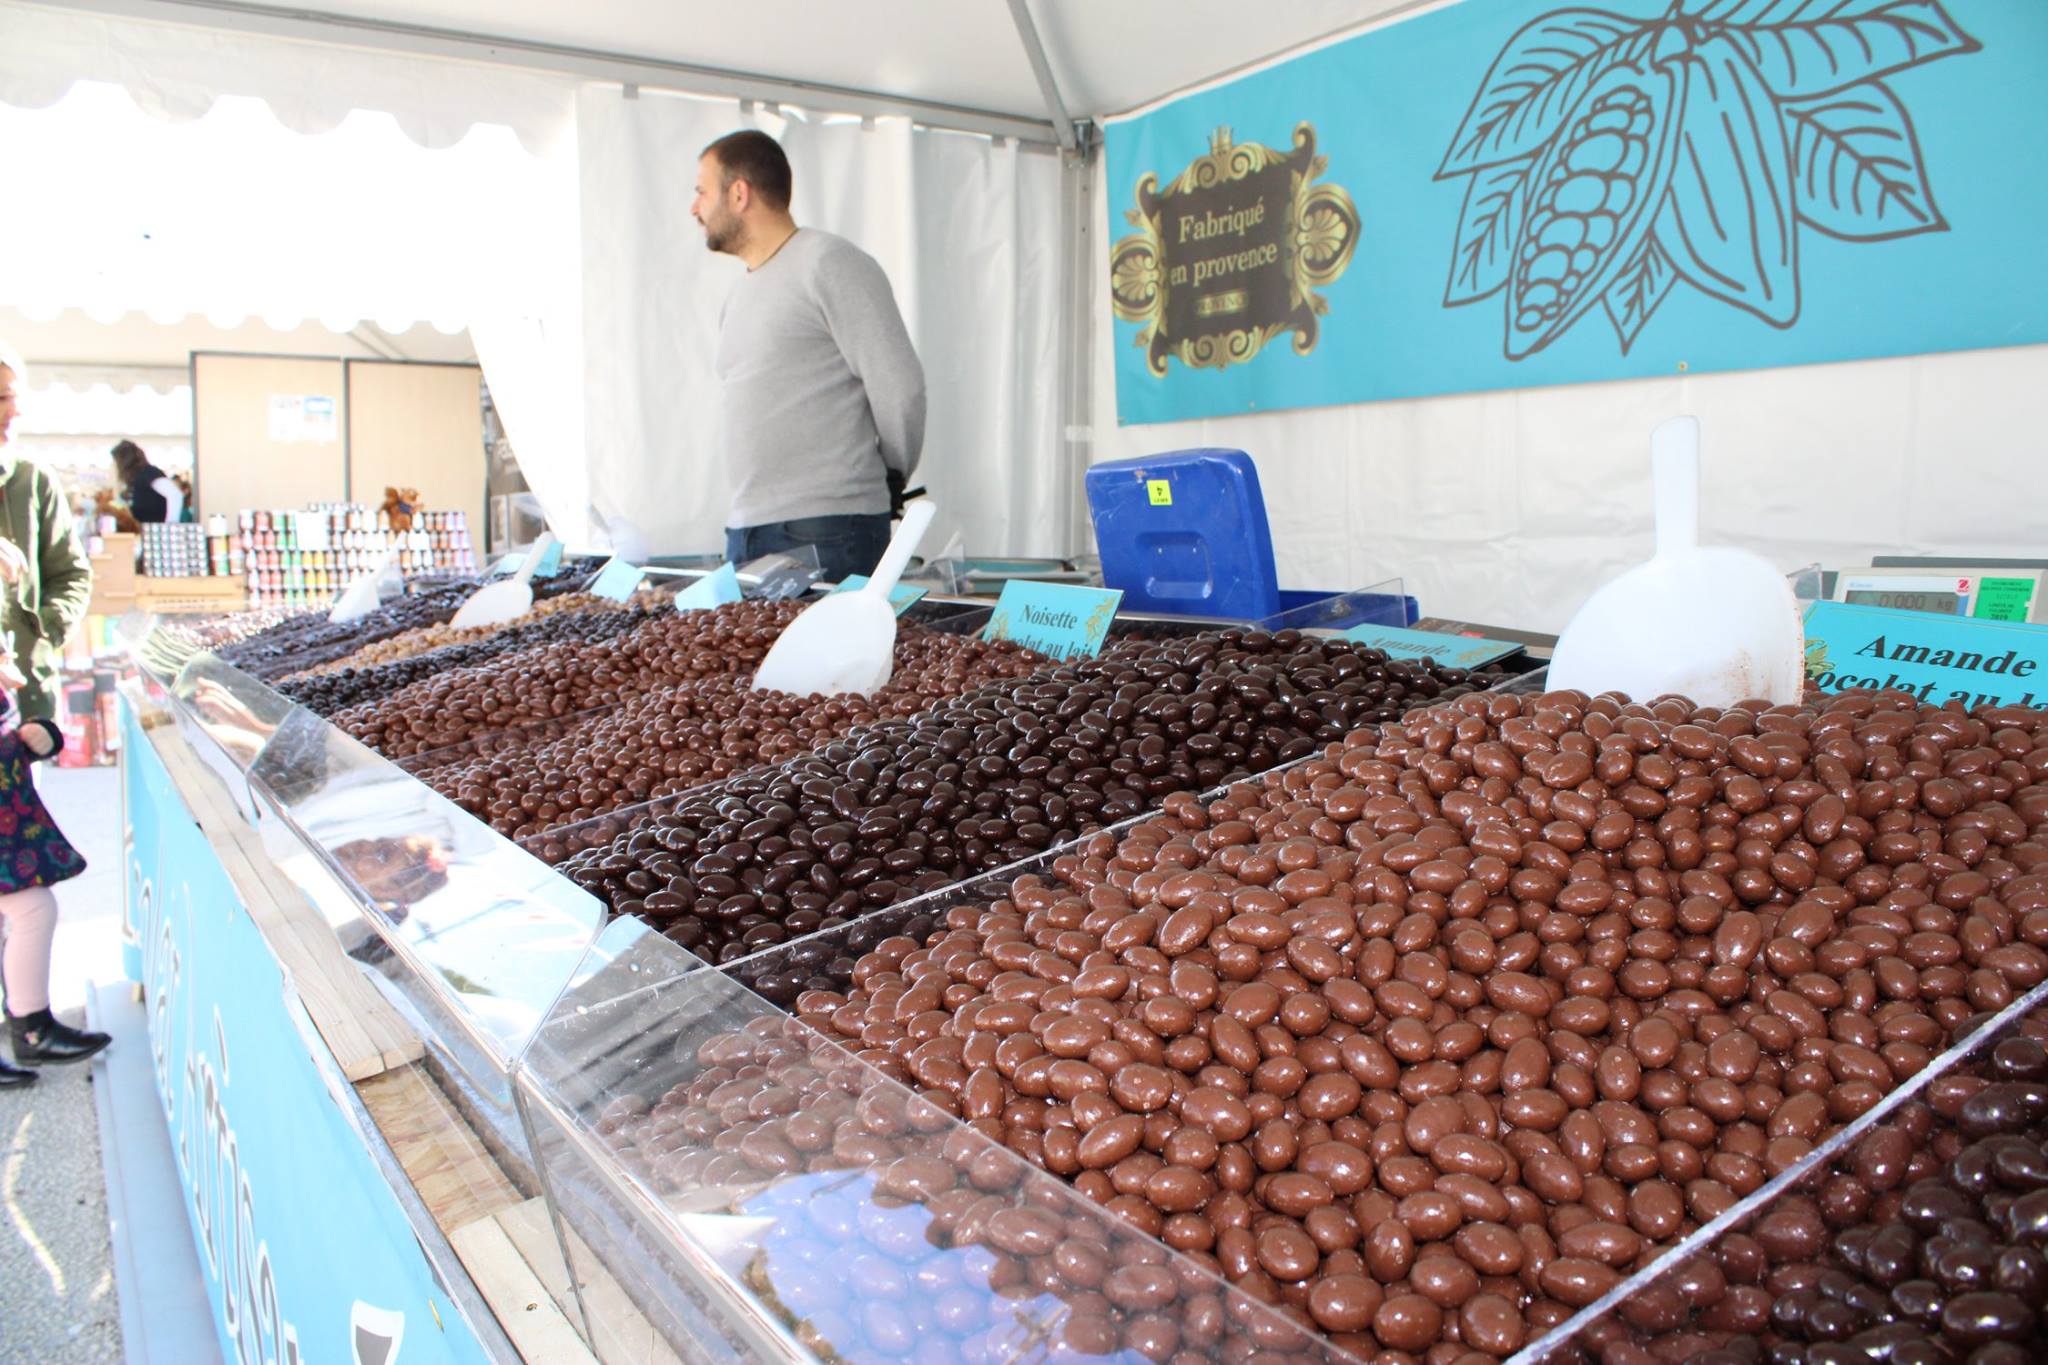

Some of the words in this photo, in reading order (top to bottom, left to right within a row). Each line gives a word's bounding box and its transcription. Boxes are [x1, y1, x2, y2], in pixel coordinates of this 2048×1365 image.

[1179, 196, 1265, 242] Fabriqué
[1171, 267, 1187, 287] en
[1193, 242, 1278, 288] provence
[1019, 604, 1078, 629] Noisette
[1854, 635, 2037, 677] Amande
